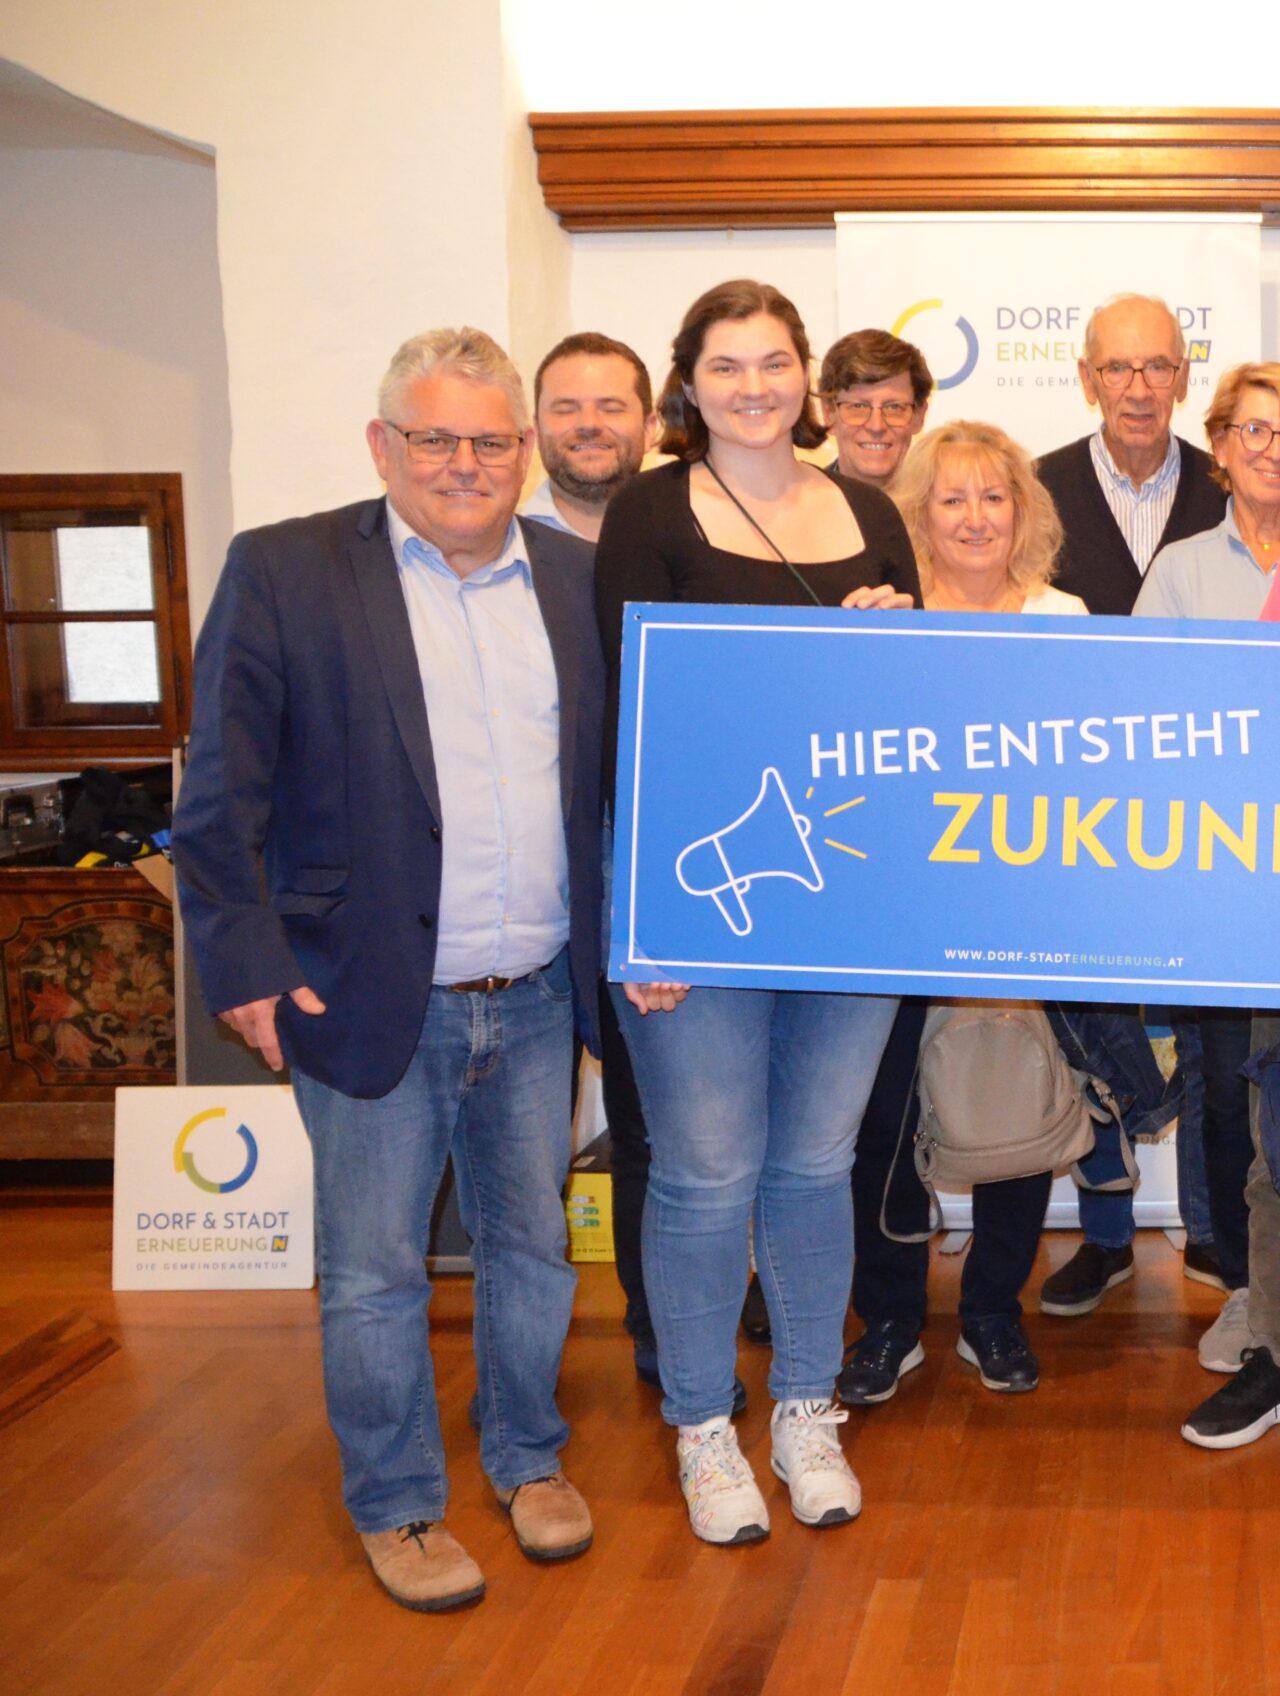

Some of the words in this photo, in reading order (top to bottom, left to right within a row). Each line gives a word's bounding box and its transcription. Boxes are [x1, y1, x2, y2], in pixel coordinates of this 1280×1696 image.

[997, 306, 1080, 330] DORF
[997, 376, 1024, 387] DIE
[810, 726, 941, 777] HIER
[965, 709, 1260, 769] ENTSTEHT
[944, 949, 1185, 969] WWW.DORF-STADTERNEUERUNG.AT
[137, 1212, 197, 1230] DORF
[203, 1211, 216, 1230] &
[224, 1211, 290, 1229] STADT
[136, 1237, 267, 1252] ERNEUERUNG
[136, 1262, 156, 1271] DIE
[164, 1262, 288, 1271] GEMEINDEAGENTUR
